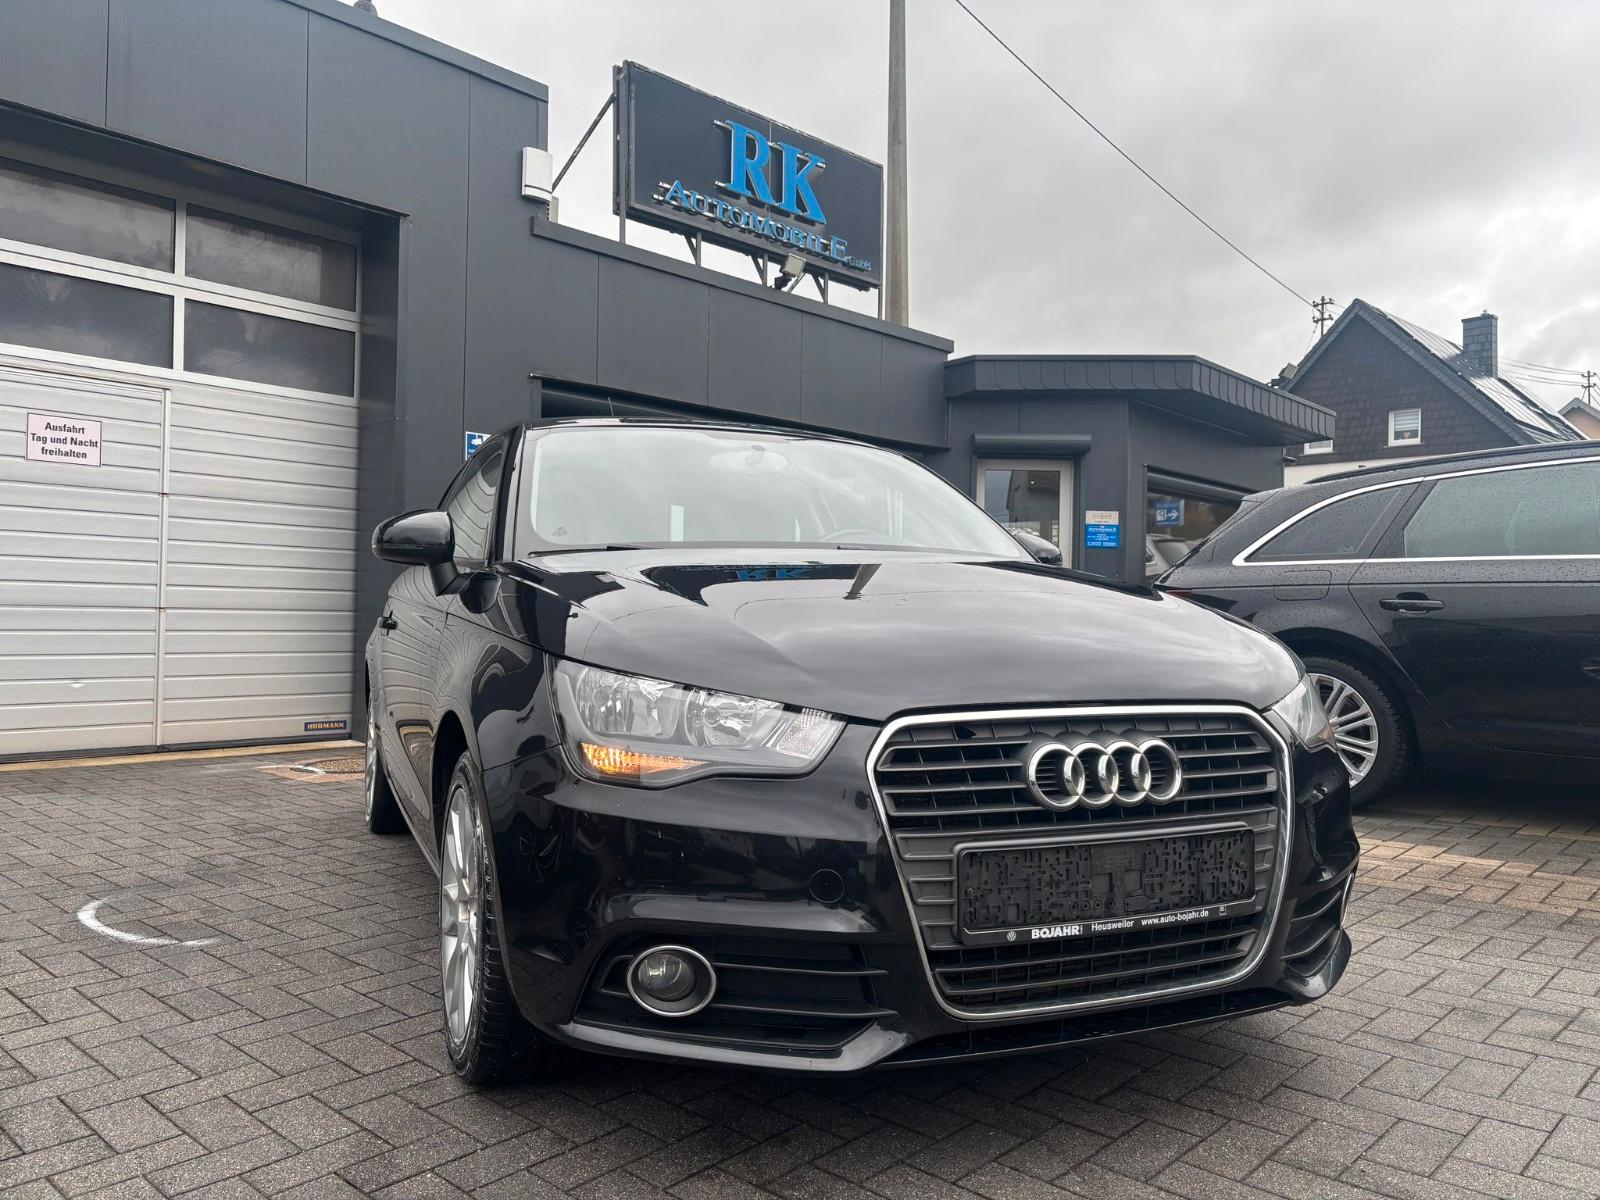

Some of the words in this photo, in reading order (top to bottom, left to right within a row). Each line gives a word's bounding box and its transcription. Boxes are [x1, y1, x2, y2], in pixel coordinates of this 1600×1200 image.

[716, 119, 828, 225] RK
[656, 180, 849, 262] AUTOMOBILE
[44, 422, 85, 435] Ausfahrt
[30, 433, 48, 445] Tag
[50, 437, 67, 445] und
[70, 437, 98, 448] Nacht
[41, 446, 87, 459] freihalten
[1031, 925, 1079, 939] BOJAHR
[1091, 919, 1134, 932] Heusweiler
[1141, 908, 1209, 926] www.auto-bojahr.de
